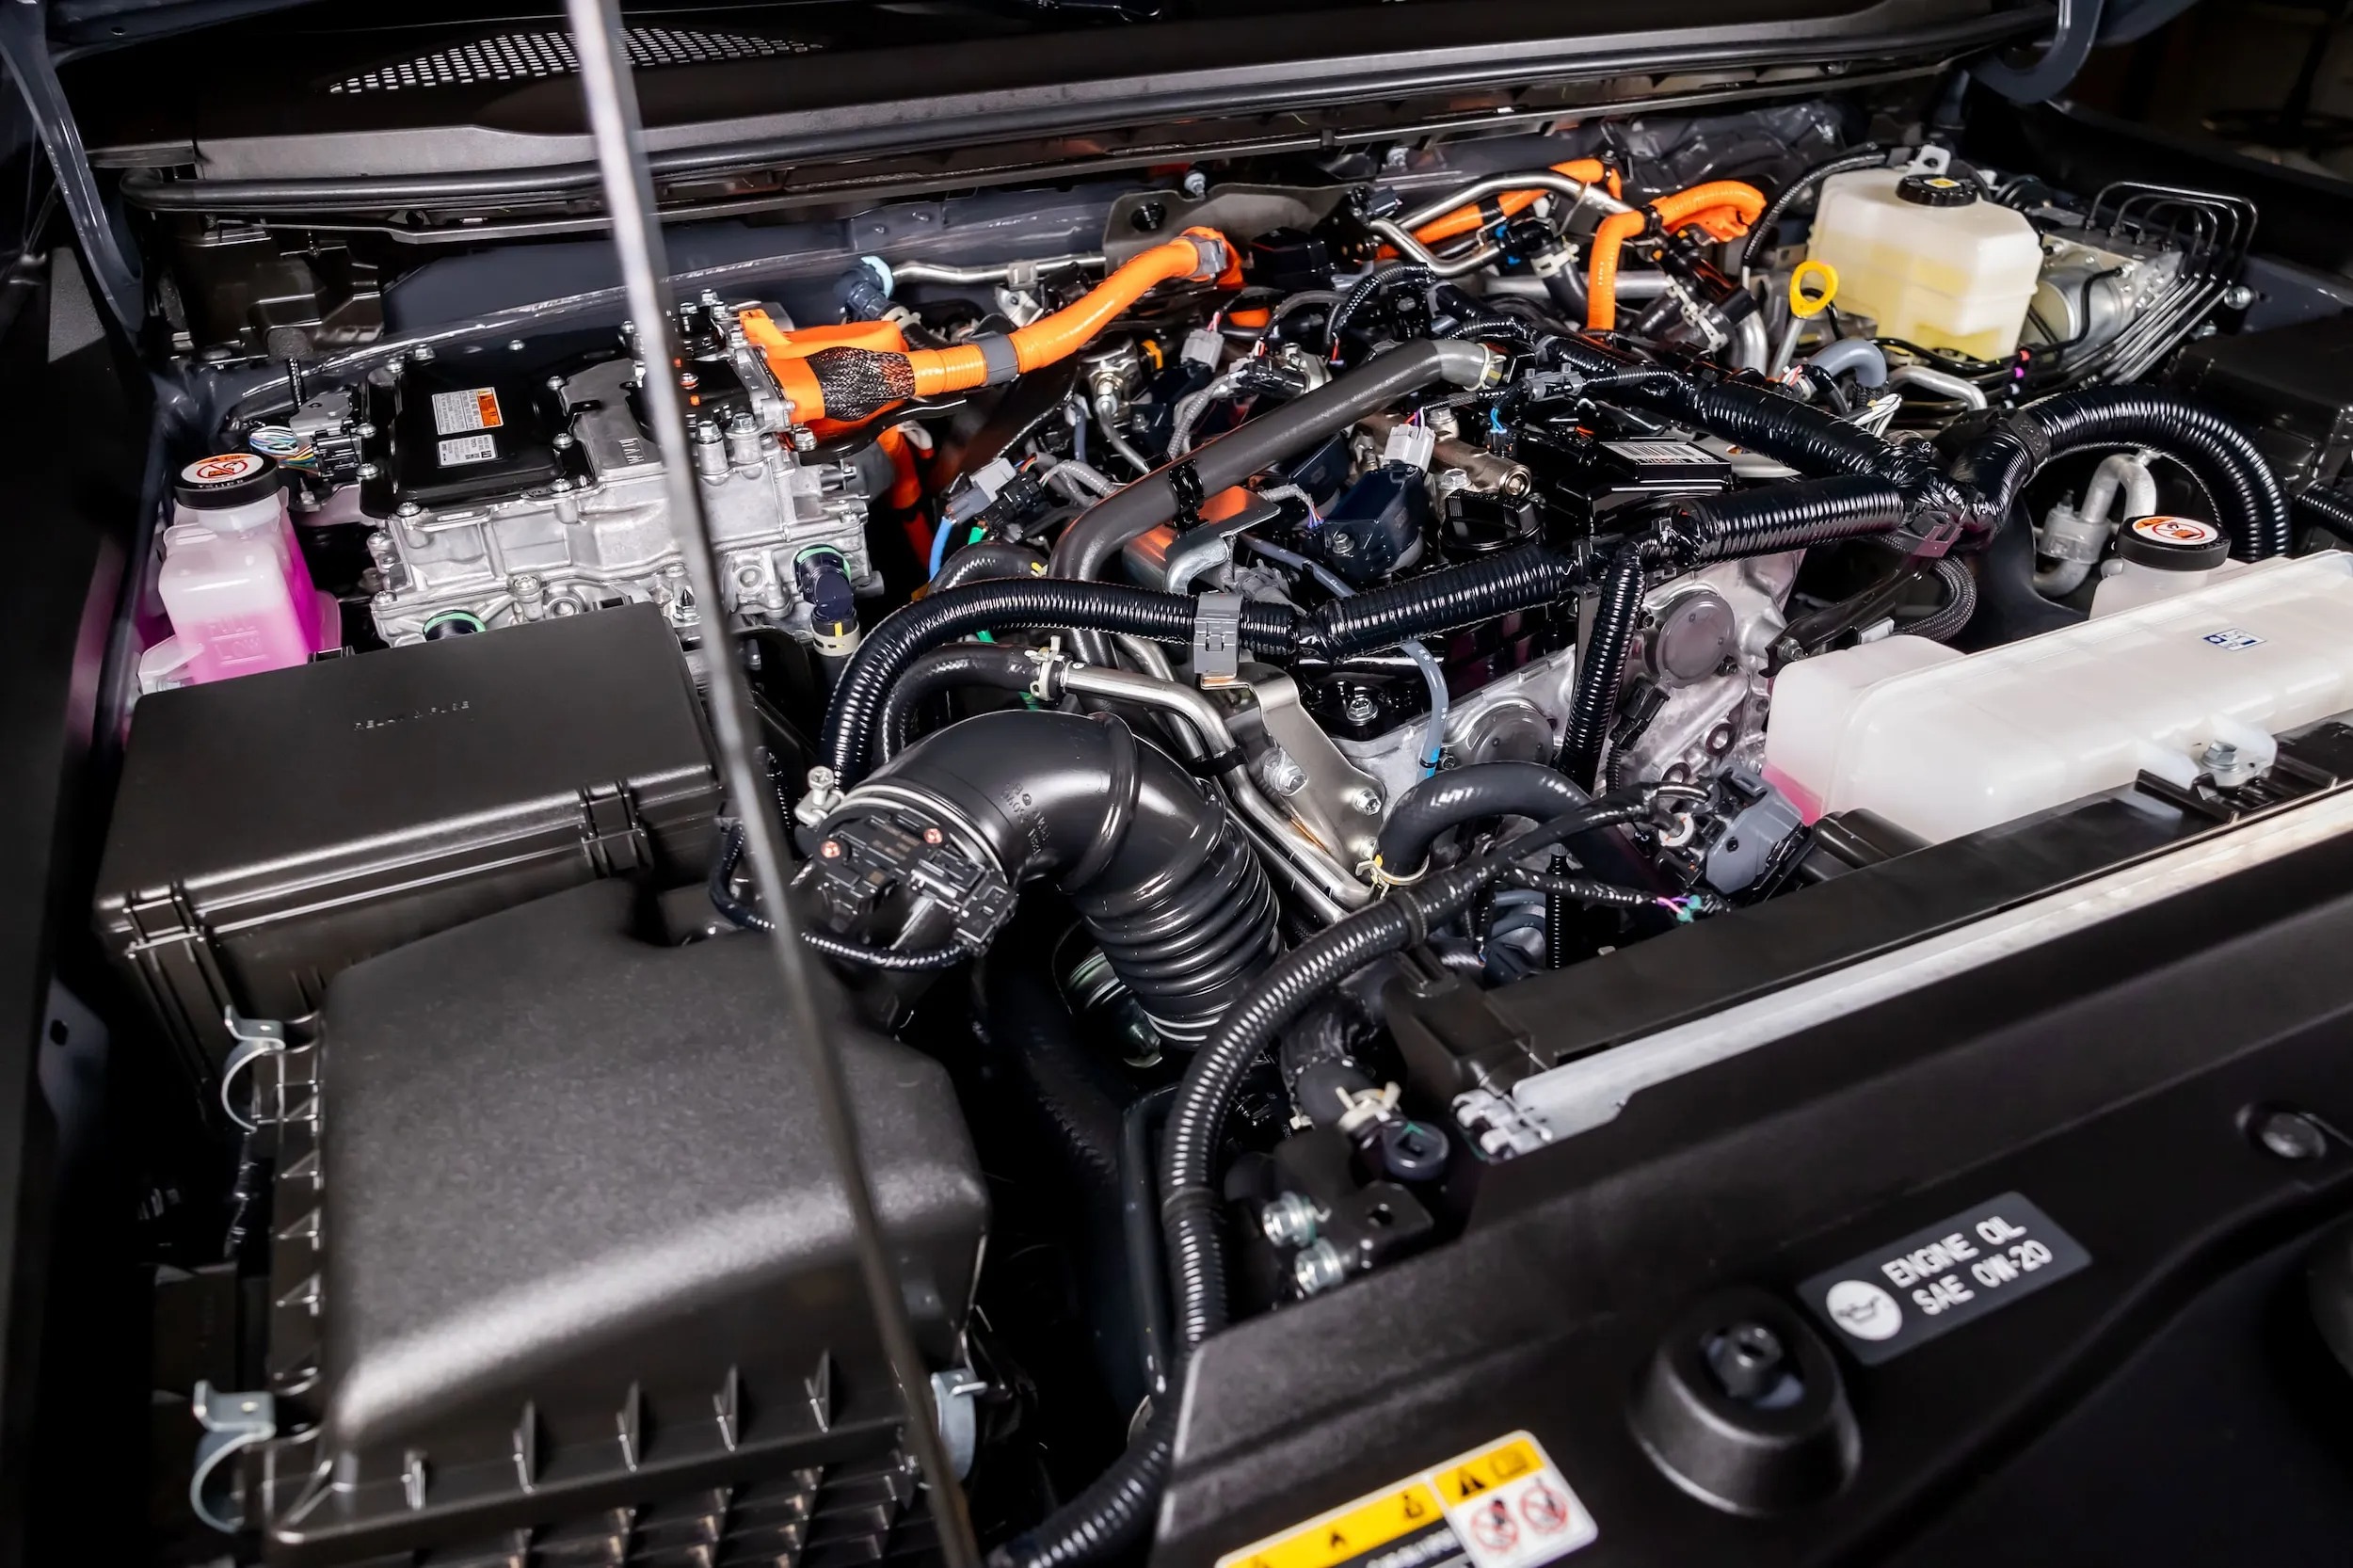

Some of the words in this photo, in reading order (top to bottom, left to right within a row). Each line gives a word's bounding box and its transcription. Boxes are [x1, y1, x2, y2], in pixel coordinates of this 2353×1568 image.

[215, 637, 263, 660] LOW
[1881, 1233, 1979, 1288] ENGINE
[1976, 1216, 2027, 1245] OIL
[1912, 1274, 1976, 1316] SAE
[1972, 1240, 2053, 1288] 0W-20
